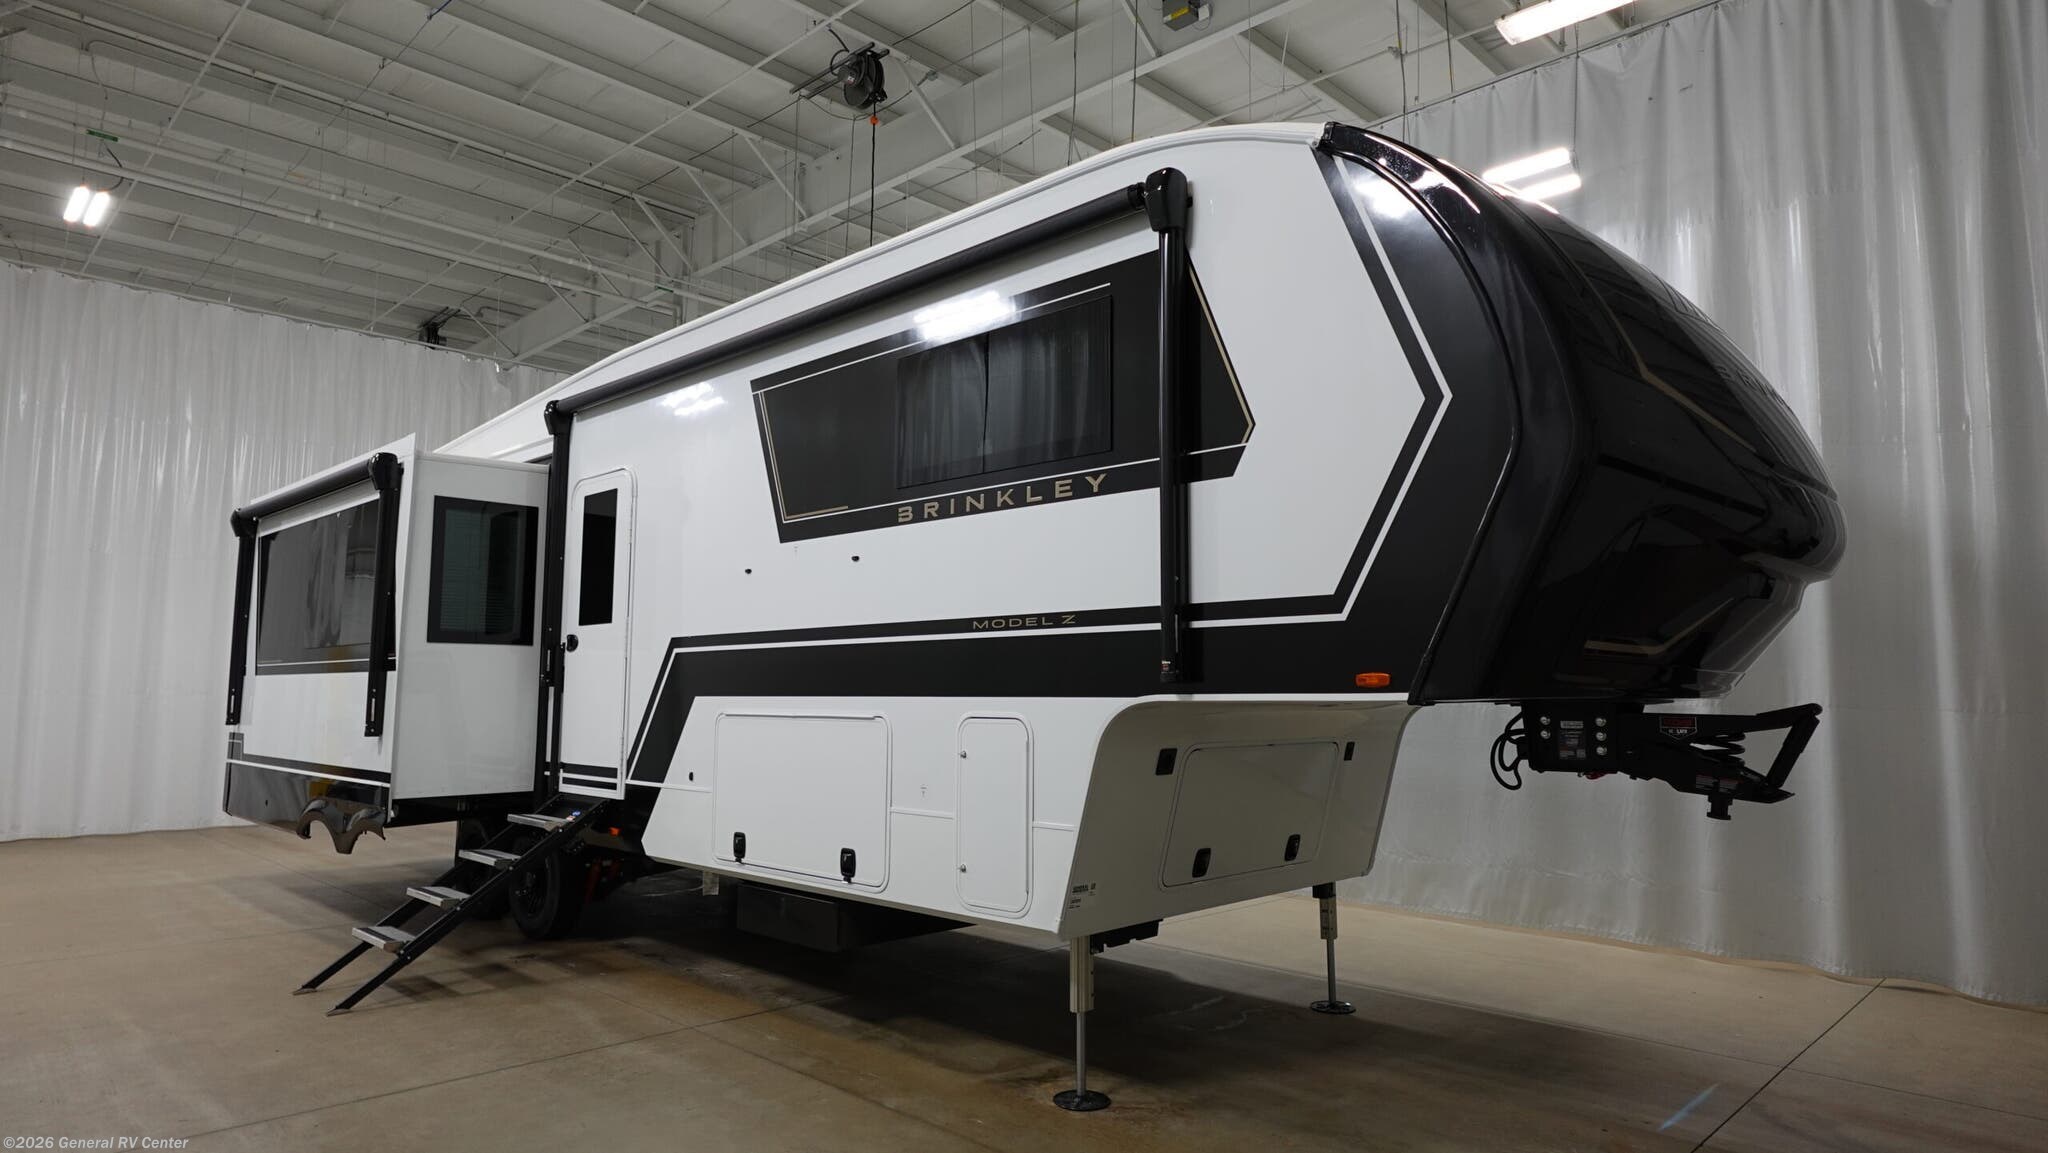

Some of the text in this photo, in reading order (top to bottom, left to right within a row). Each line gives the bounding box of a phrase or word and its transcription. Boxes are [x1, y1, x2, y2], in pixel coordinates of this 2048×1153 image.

[898, 473, 1107, 523] BRINKLEY
[973, 614, 1076, 629] MODEL Z
